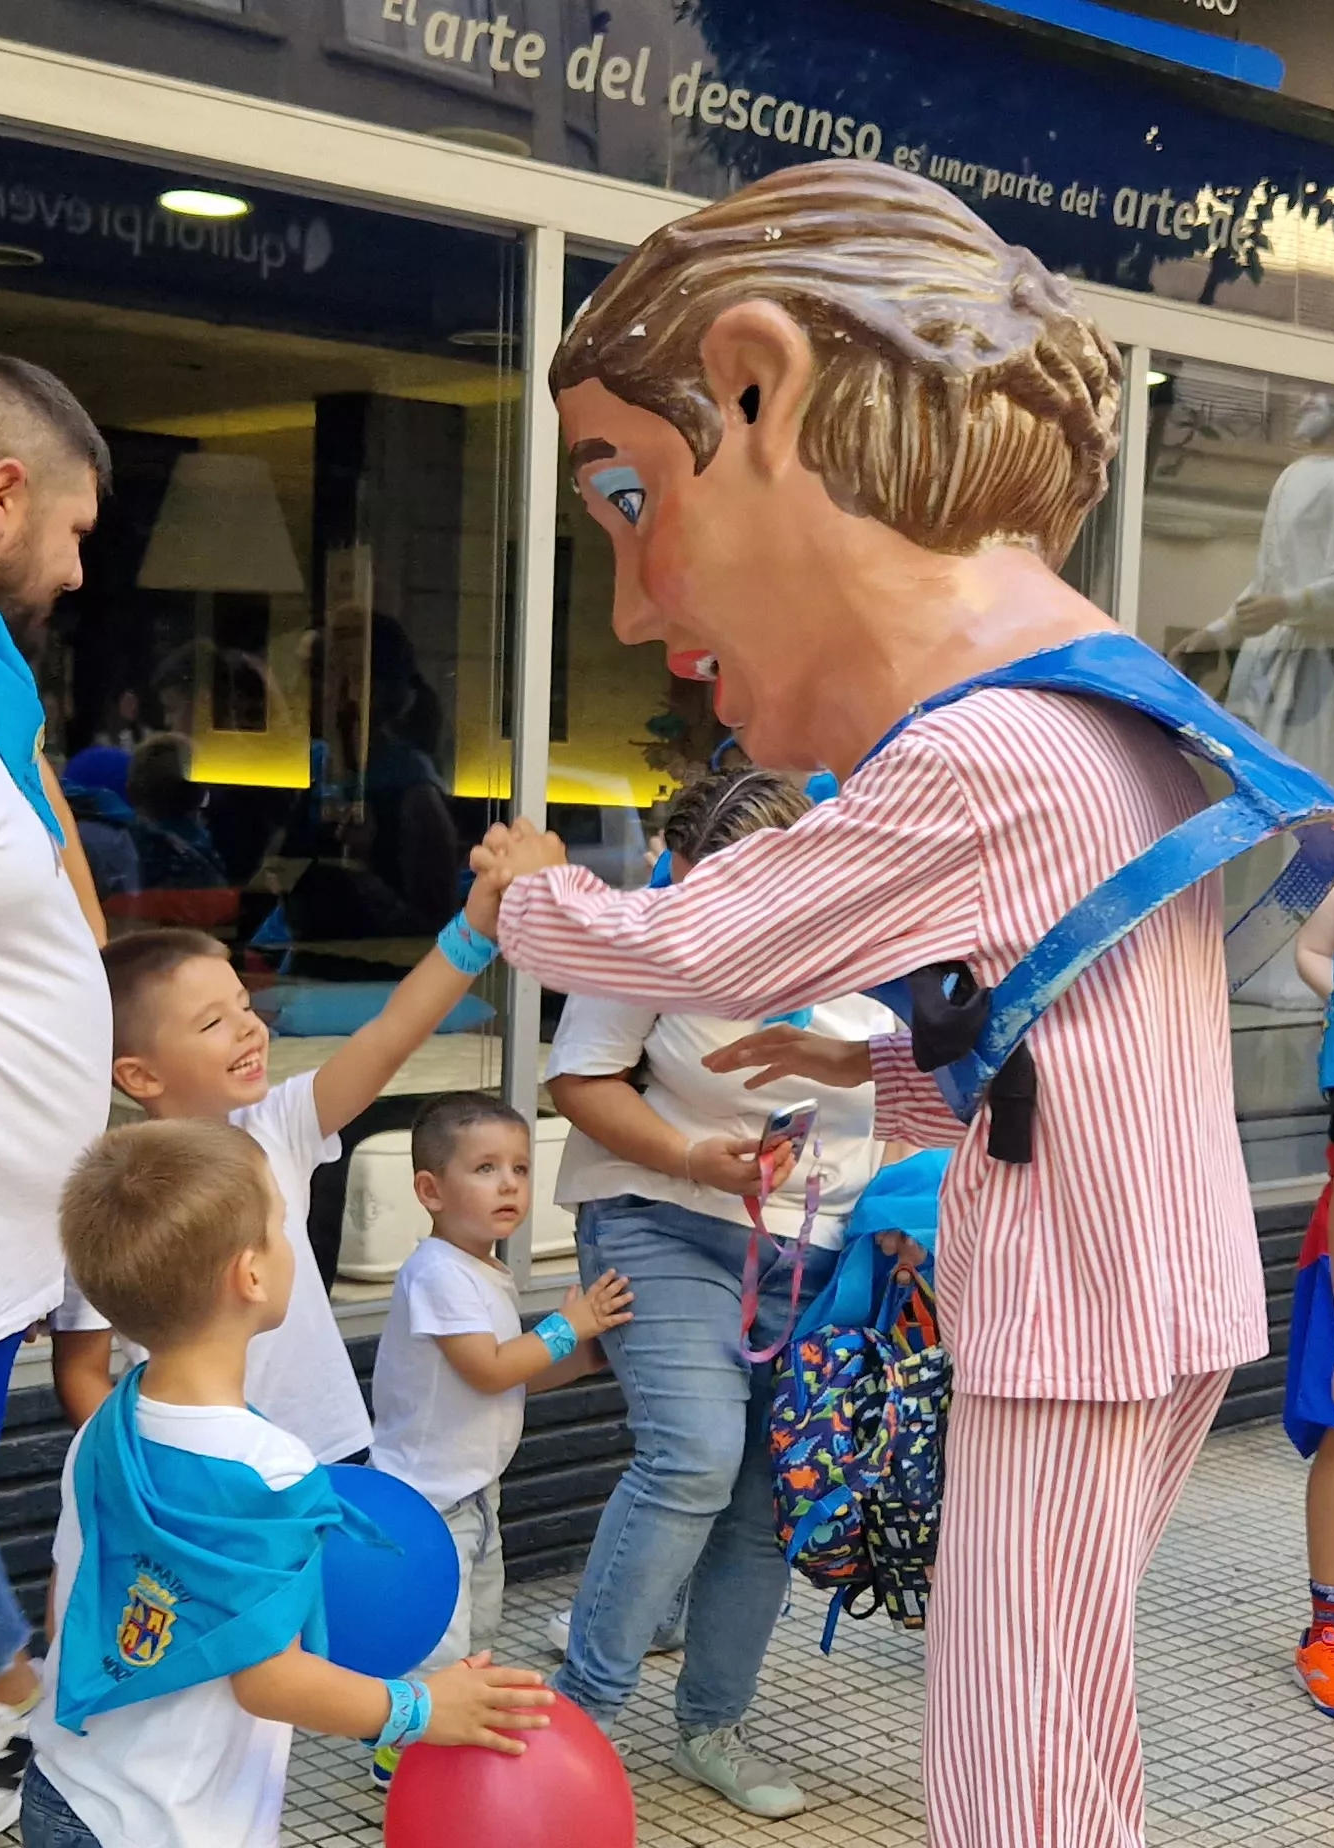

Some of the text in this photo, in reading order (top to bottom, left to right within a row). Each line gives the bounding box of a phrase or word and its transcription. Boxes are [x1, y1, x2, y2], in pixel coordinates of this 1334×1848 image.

[382, 0, 417, 26] El
[424, 10, 546, 78] arte
[567, 33, 651, 106] del
[668, 60, 883, 161] descanso
[893, 145, 922, 173] es
[929, 154, 978, 187] una
[982, 168, 1052, 208] parte
[1061, 181, 1098, 219] del
[1113, 186, 1195, 241] arte
